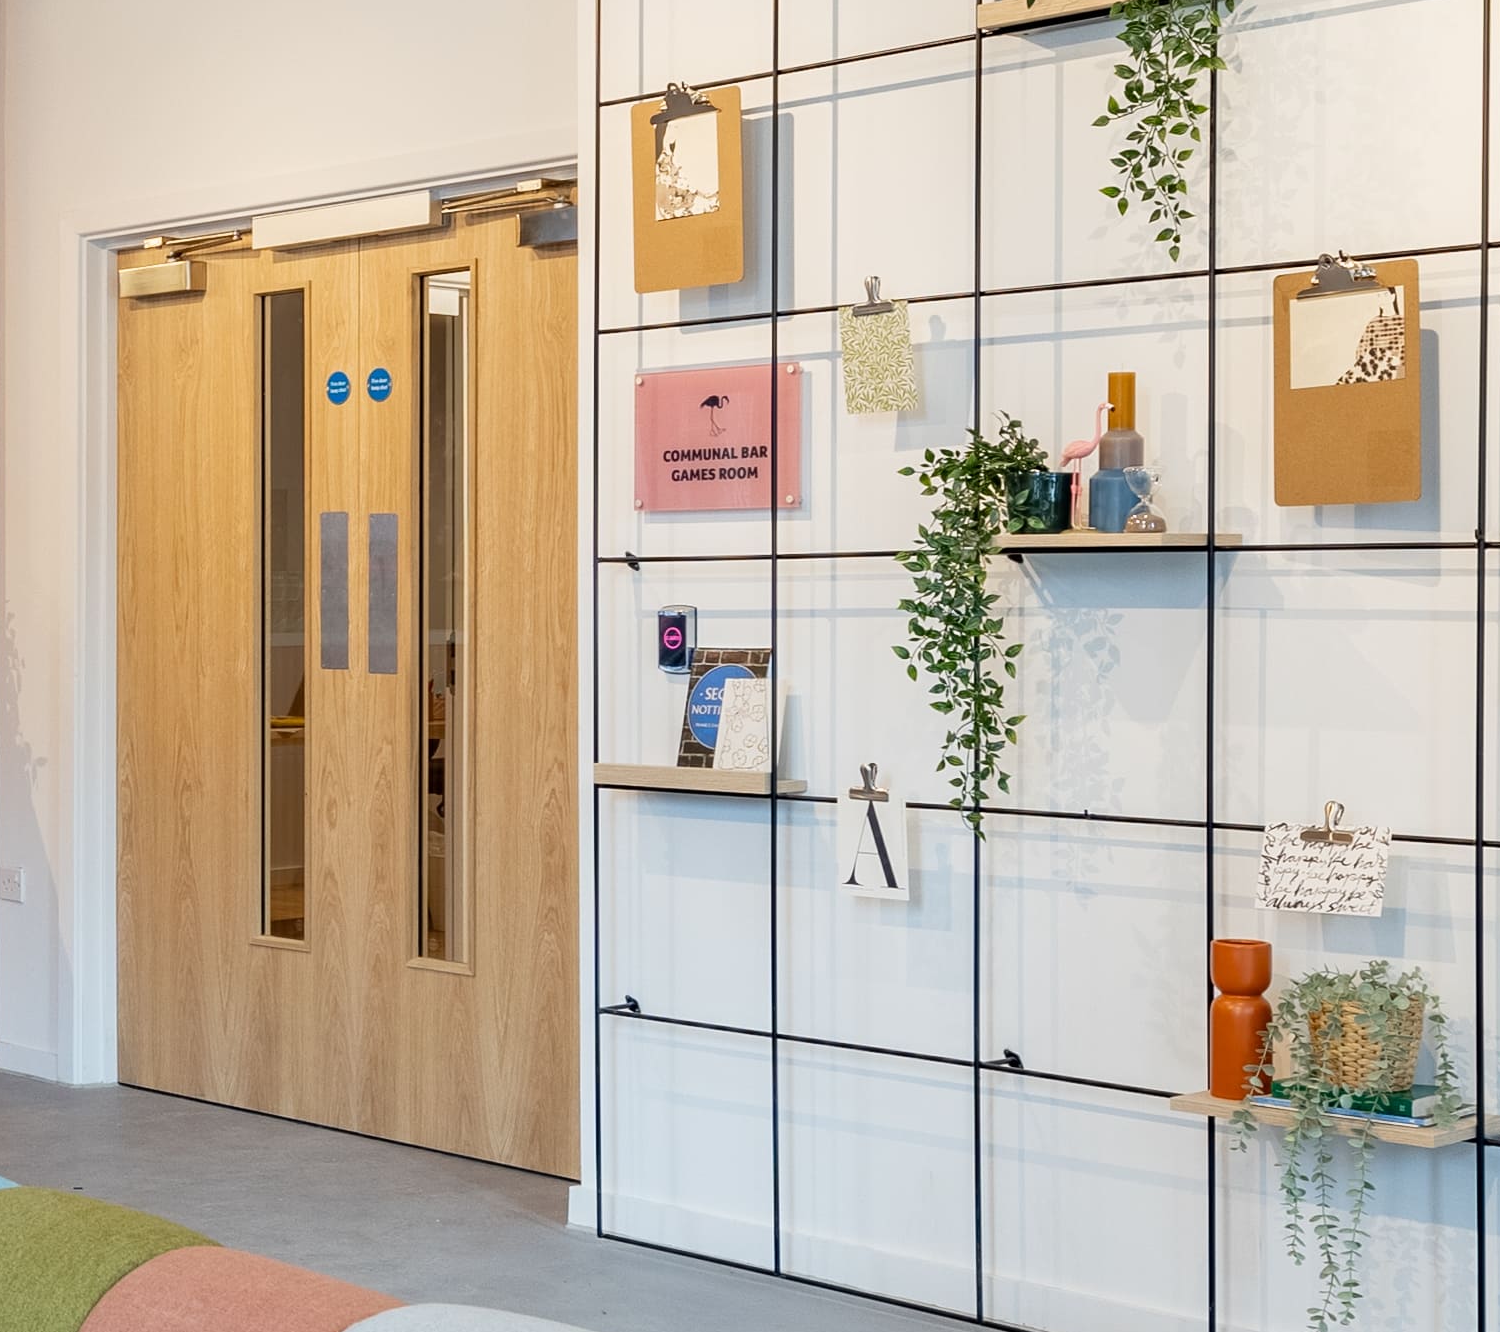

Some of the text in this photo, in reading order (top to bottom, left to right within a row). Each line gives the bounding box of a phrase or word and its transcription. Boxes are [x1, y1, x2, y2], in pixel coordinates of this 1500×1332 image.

[663, 445, 768, 463] COMMUNAL BAR
[671, 466, 759, 482] GAMES ROOM
[841, 800, 906, 890] A
